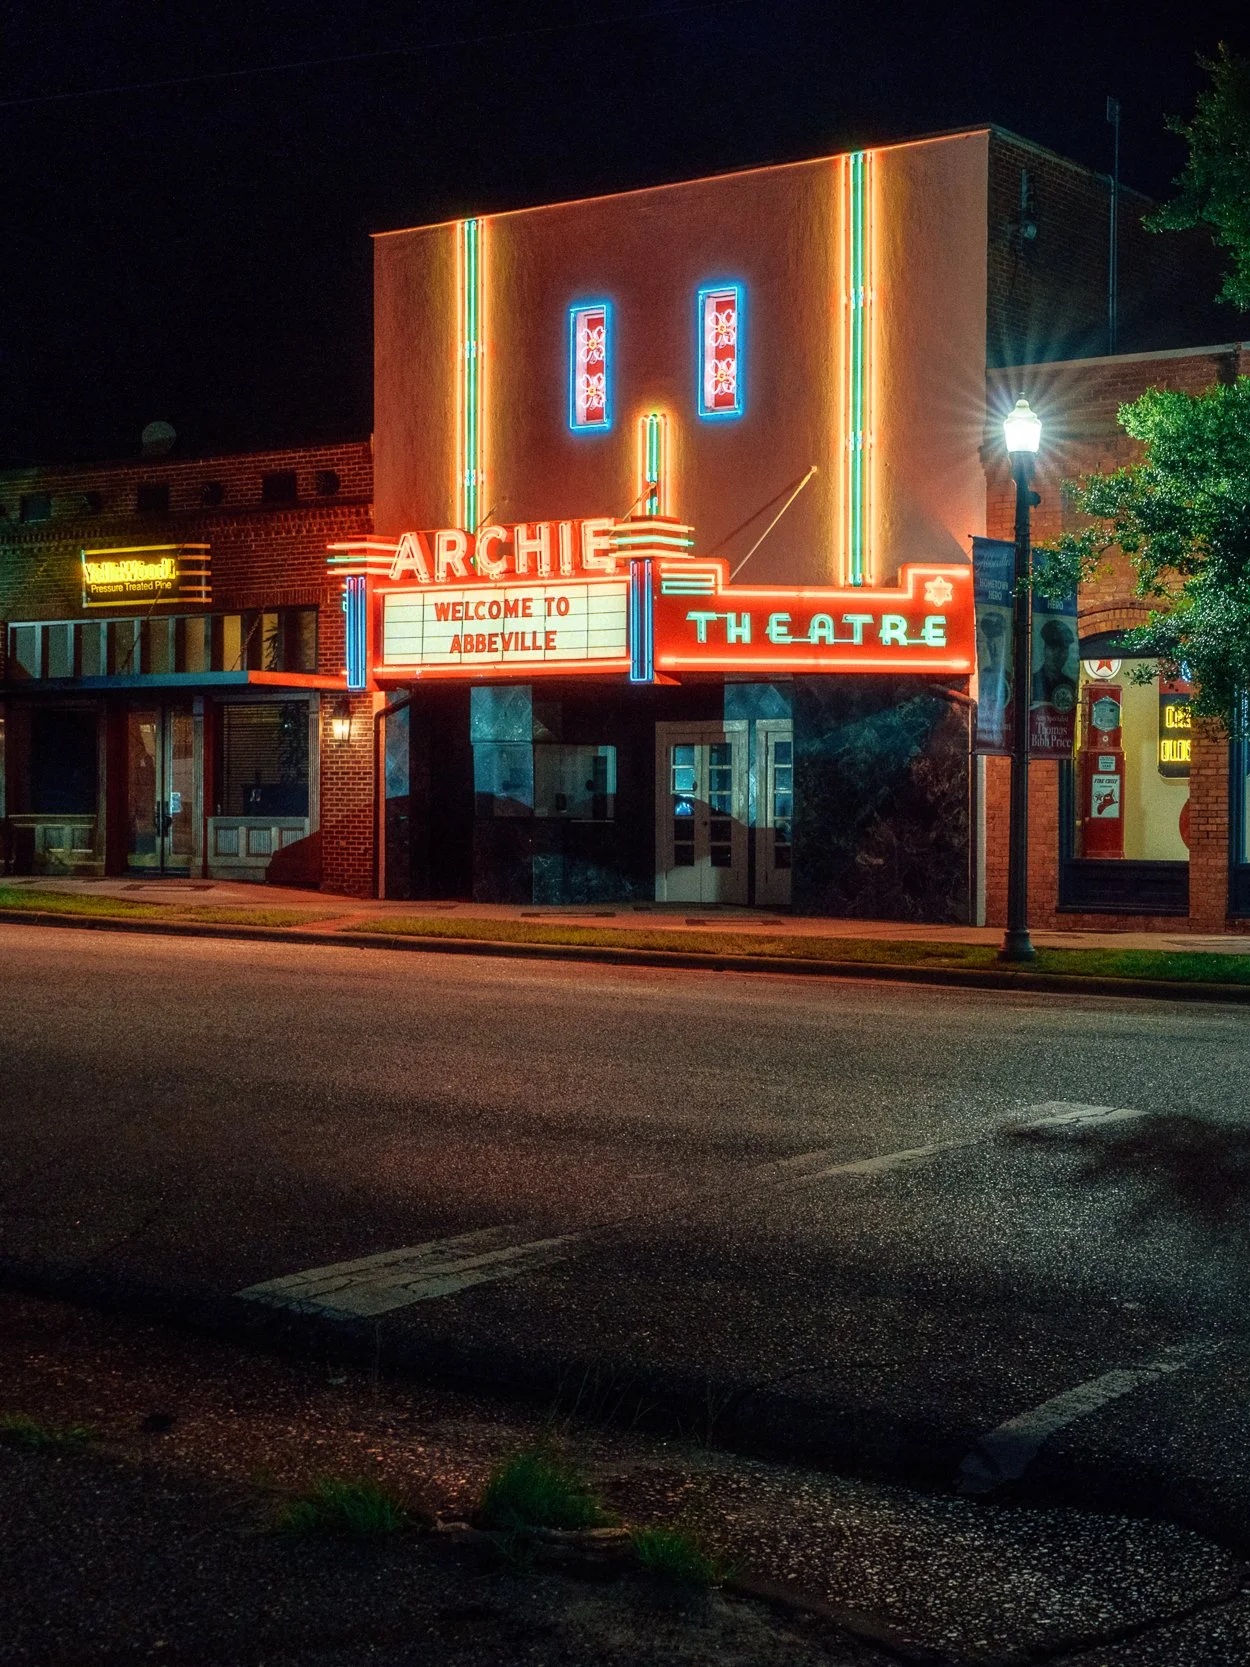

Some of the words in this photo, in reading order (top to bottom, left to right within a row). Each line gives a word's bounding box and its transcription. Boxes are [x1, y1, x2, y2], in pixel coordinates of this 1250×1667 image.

[388, 518, 617, 582] ARCHIE
[91, 584, 124, 594] Pressure
[124, 581, 153, 591] Treated
[155, 580, 172, 590] Pine
[434, 597, 534, 622] WELCOME
[546, 596, 570, 617] TO
[1047, 598, 1064, 611] HERO
[686, 611, 947, 647] THEATRE
[449, 630, 557, 655] ABBEVILLE
[1035, 721, 1068, 735] Thomas
[1031, 733, 1050, 747] Bibb
[1051, 734, 1072, 748] Price
